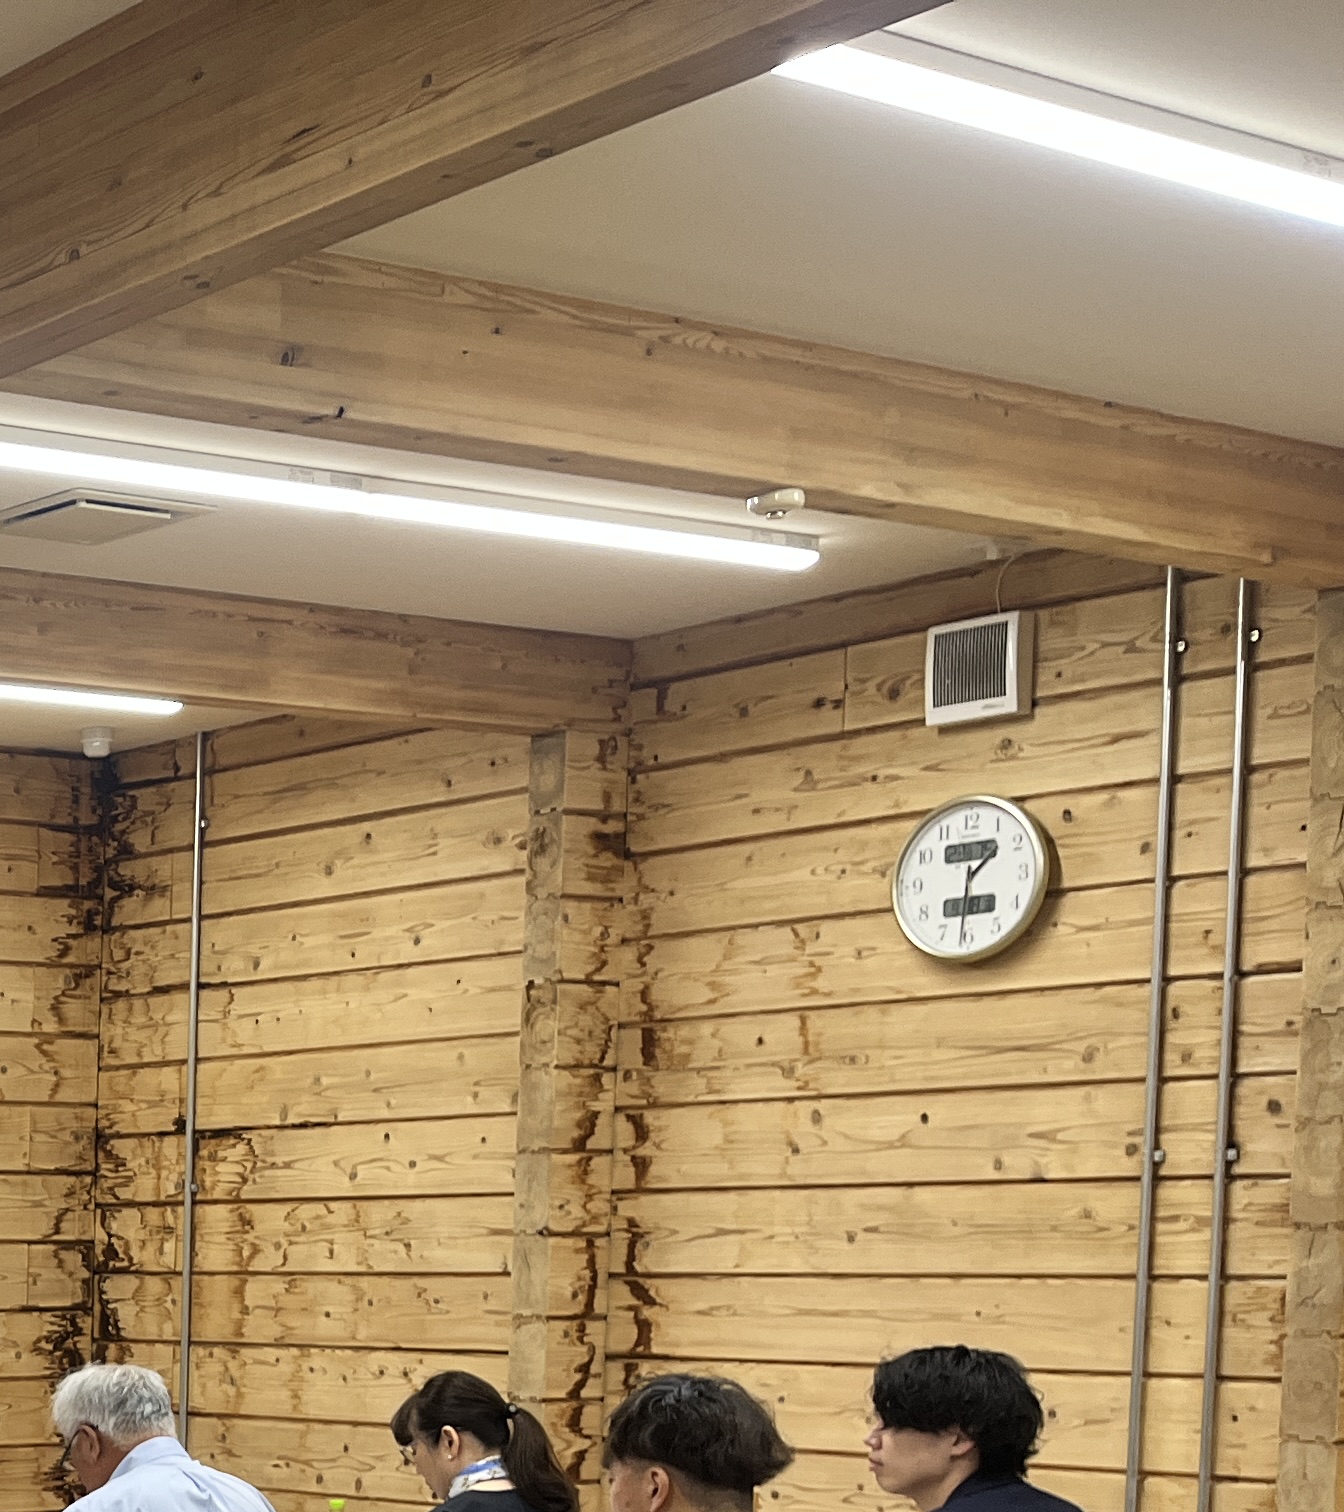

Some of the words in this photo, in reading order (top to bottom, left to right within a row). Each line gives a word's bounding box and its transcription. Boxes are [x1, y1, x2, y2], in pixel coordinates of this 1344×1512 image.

[964, 812, 980, 830] 12
[939, 824, 950, 841] 11
[1013, 834, 1023, 851] 2
[919, 848, 933, 865] 10
[1019, 863, 1029, 880] 3
[913, 877, 923, 895] 9
[919, 904, 929, 921] 8
